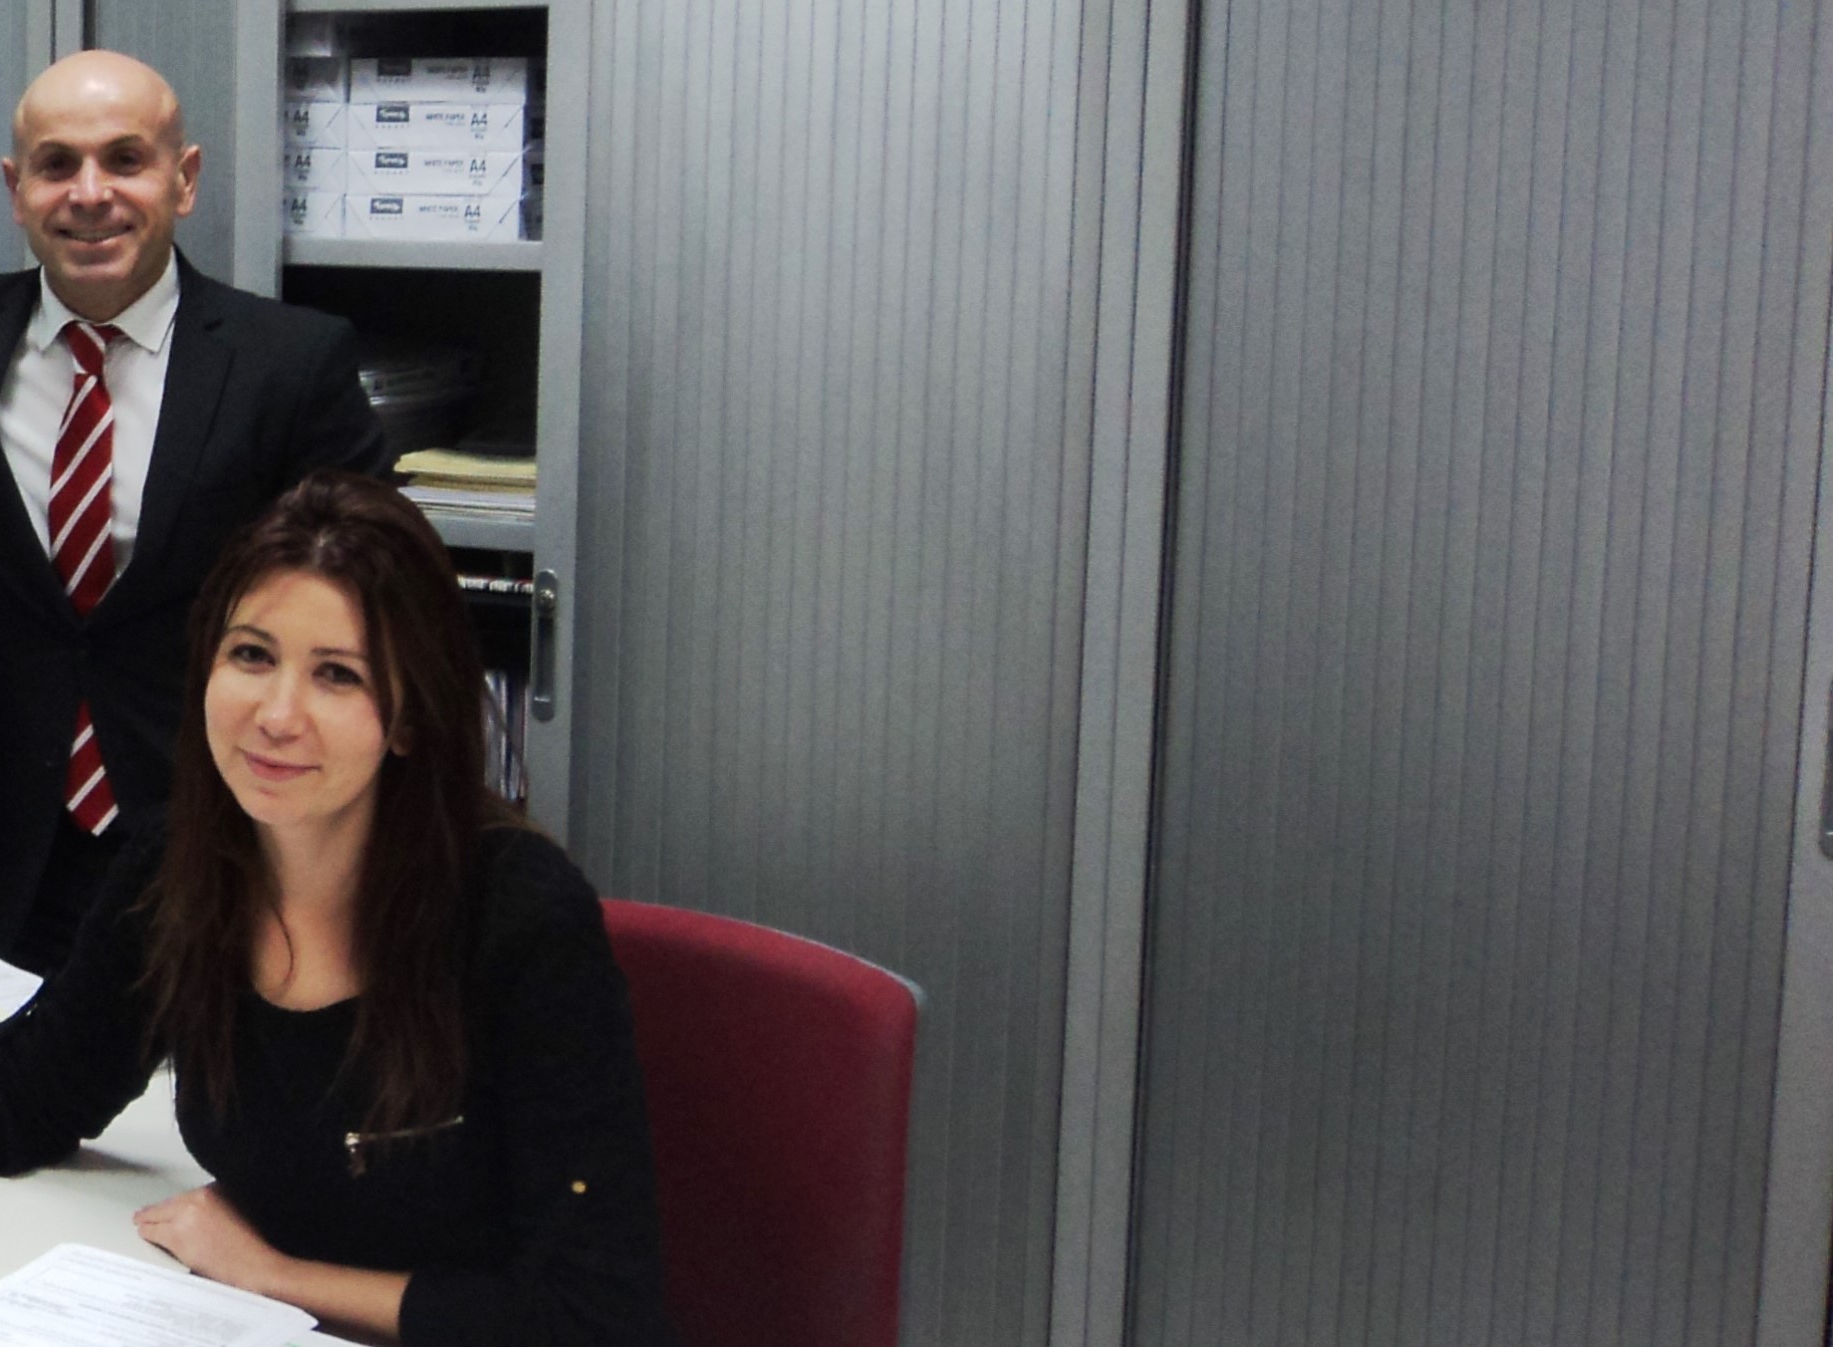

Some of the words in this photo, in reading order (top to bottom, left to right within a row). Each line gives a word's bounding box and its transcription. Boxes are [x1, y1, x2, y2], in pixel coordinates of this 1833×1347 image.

[293, 110, 309, 124] A4
[471, 112, 487, 126] A4
[295, 155, 311, 168] A4
[470, 159, 486, 172] A4
[291, 198, 307, 211] A4
[465, 204, 481, 218] A4
